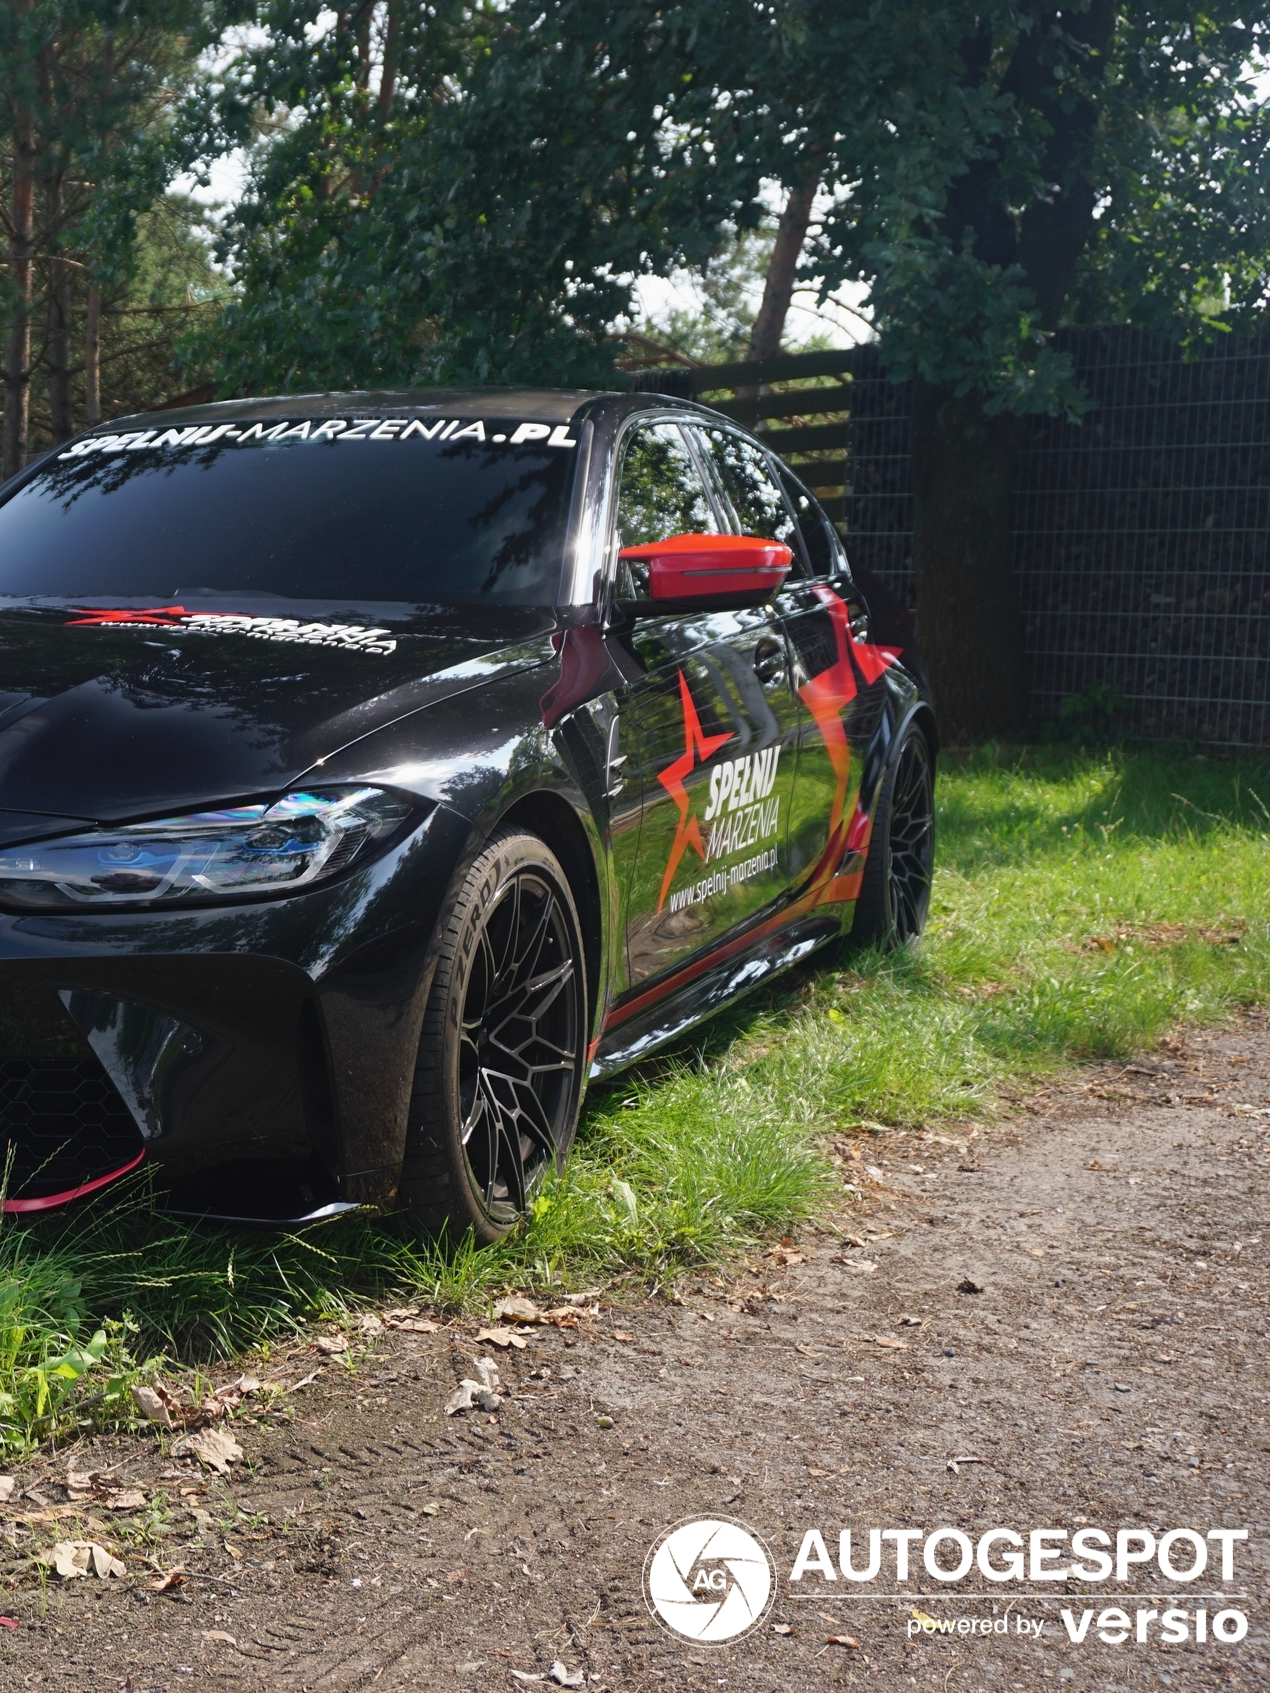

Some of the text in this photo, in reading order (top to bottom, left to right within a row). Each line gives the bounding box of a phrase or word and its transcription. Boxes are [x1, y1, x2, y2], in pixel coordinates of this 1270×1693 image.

[704, 745, 781, 821] SPEŁNIJ
[705, 795, 780, 863] MARZENIA
[670, 843, 778, 913] www.spelnij-marzenia.pl
[456, 878, 492, 990] ZERO
